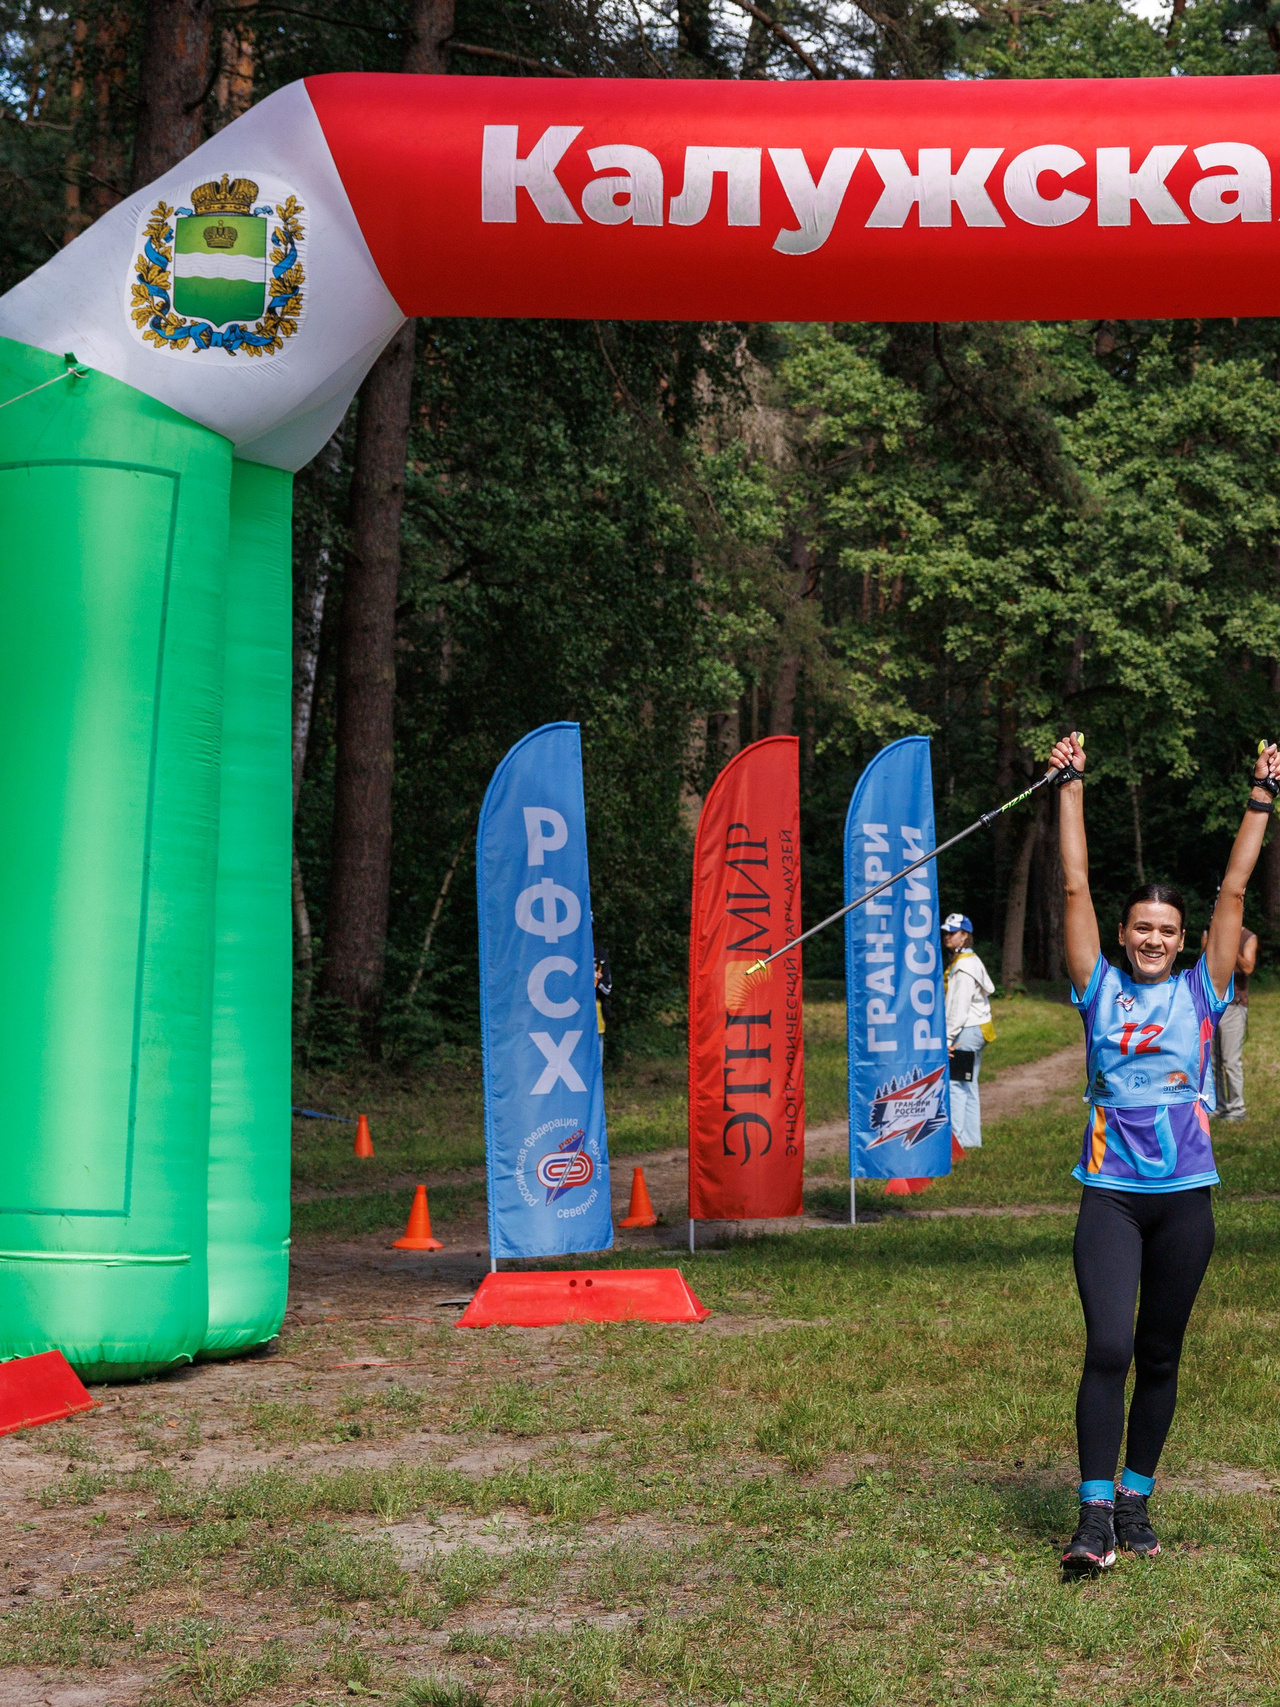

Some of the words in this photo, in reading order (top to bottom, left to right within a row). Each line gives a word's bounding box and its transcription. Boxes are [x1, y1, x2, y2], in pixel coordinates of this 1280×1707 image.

[514, 806, 588, 1096] РФСХ
[862, 823, 898, 1053] ГРАН-ПРИ
[901, 825, 943, 1051] РОССИИ
[1120, 1022, 1164, 1056] 12
[784, 957, 798, 1157] ЭТНОГРАФИЧЕСКИЙ
[894, 1100, 931, 1108] ГРАН-ПРИ
[895, 1107, 926, 1115] РОССИИ
[524, 1118, 579, 1148] федерация
[558, 1127, 584, 1151] РФСХ
[514, 1148, 540, 1207] российская
[556, 1188, 599, 1219] северной
